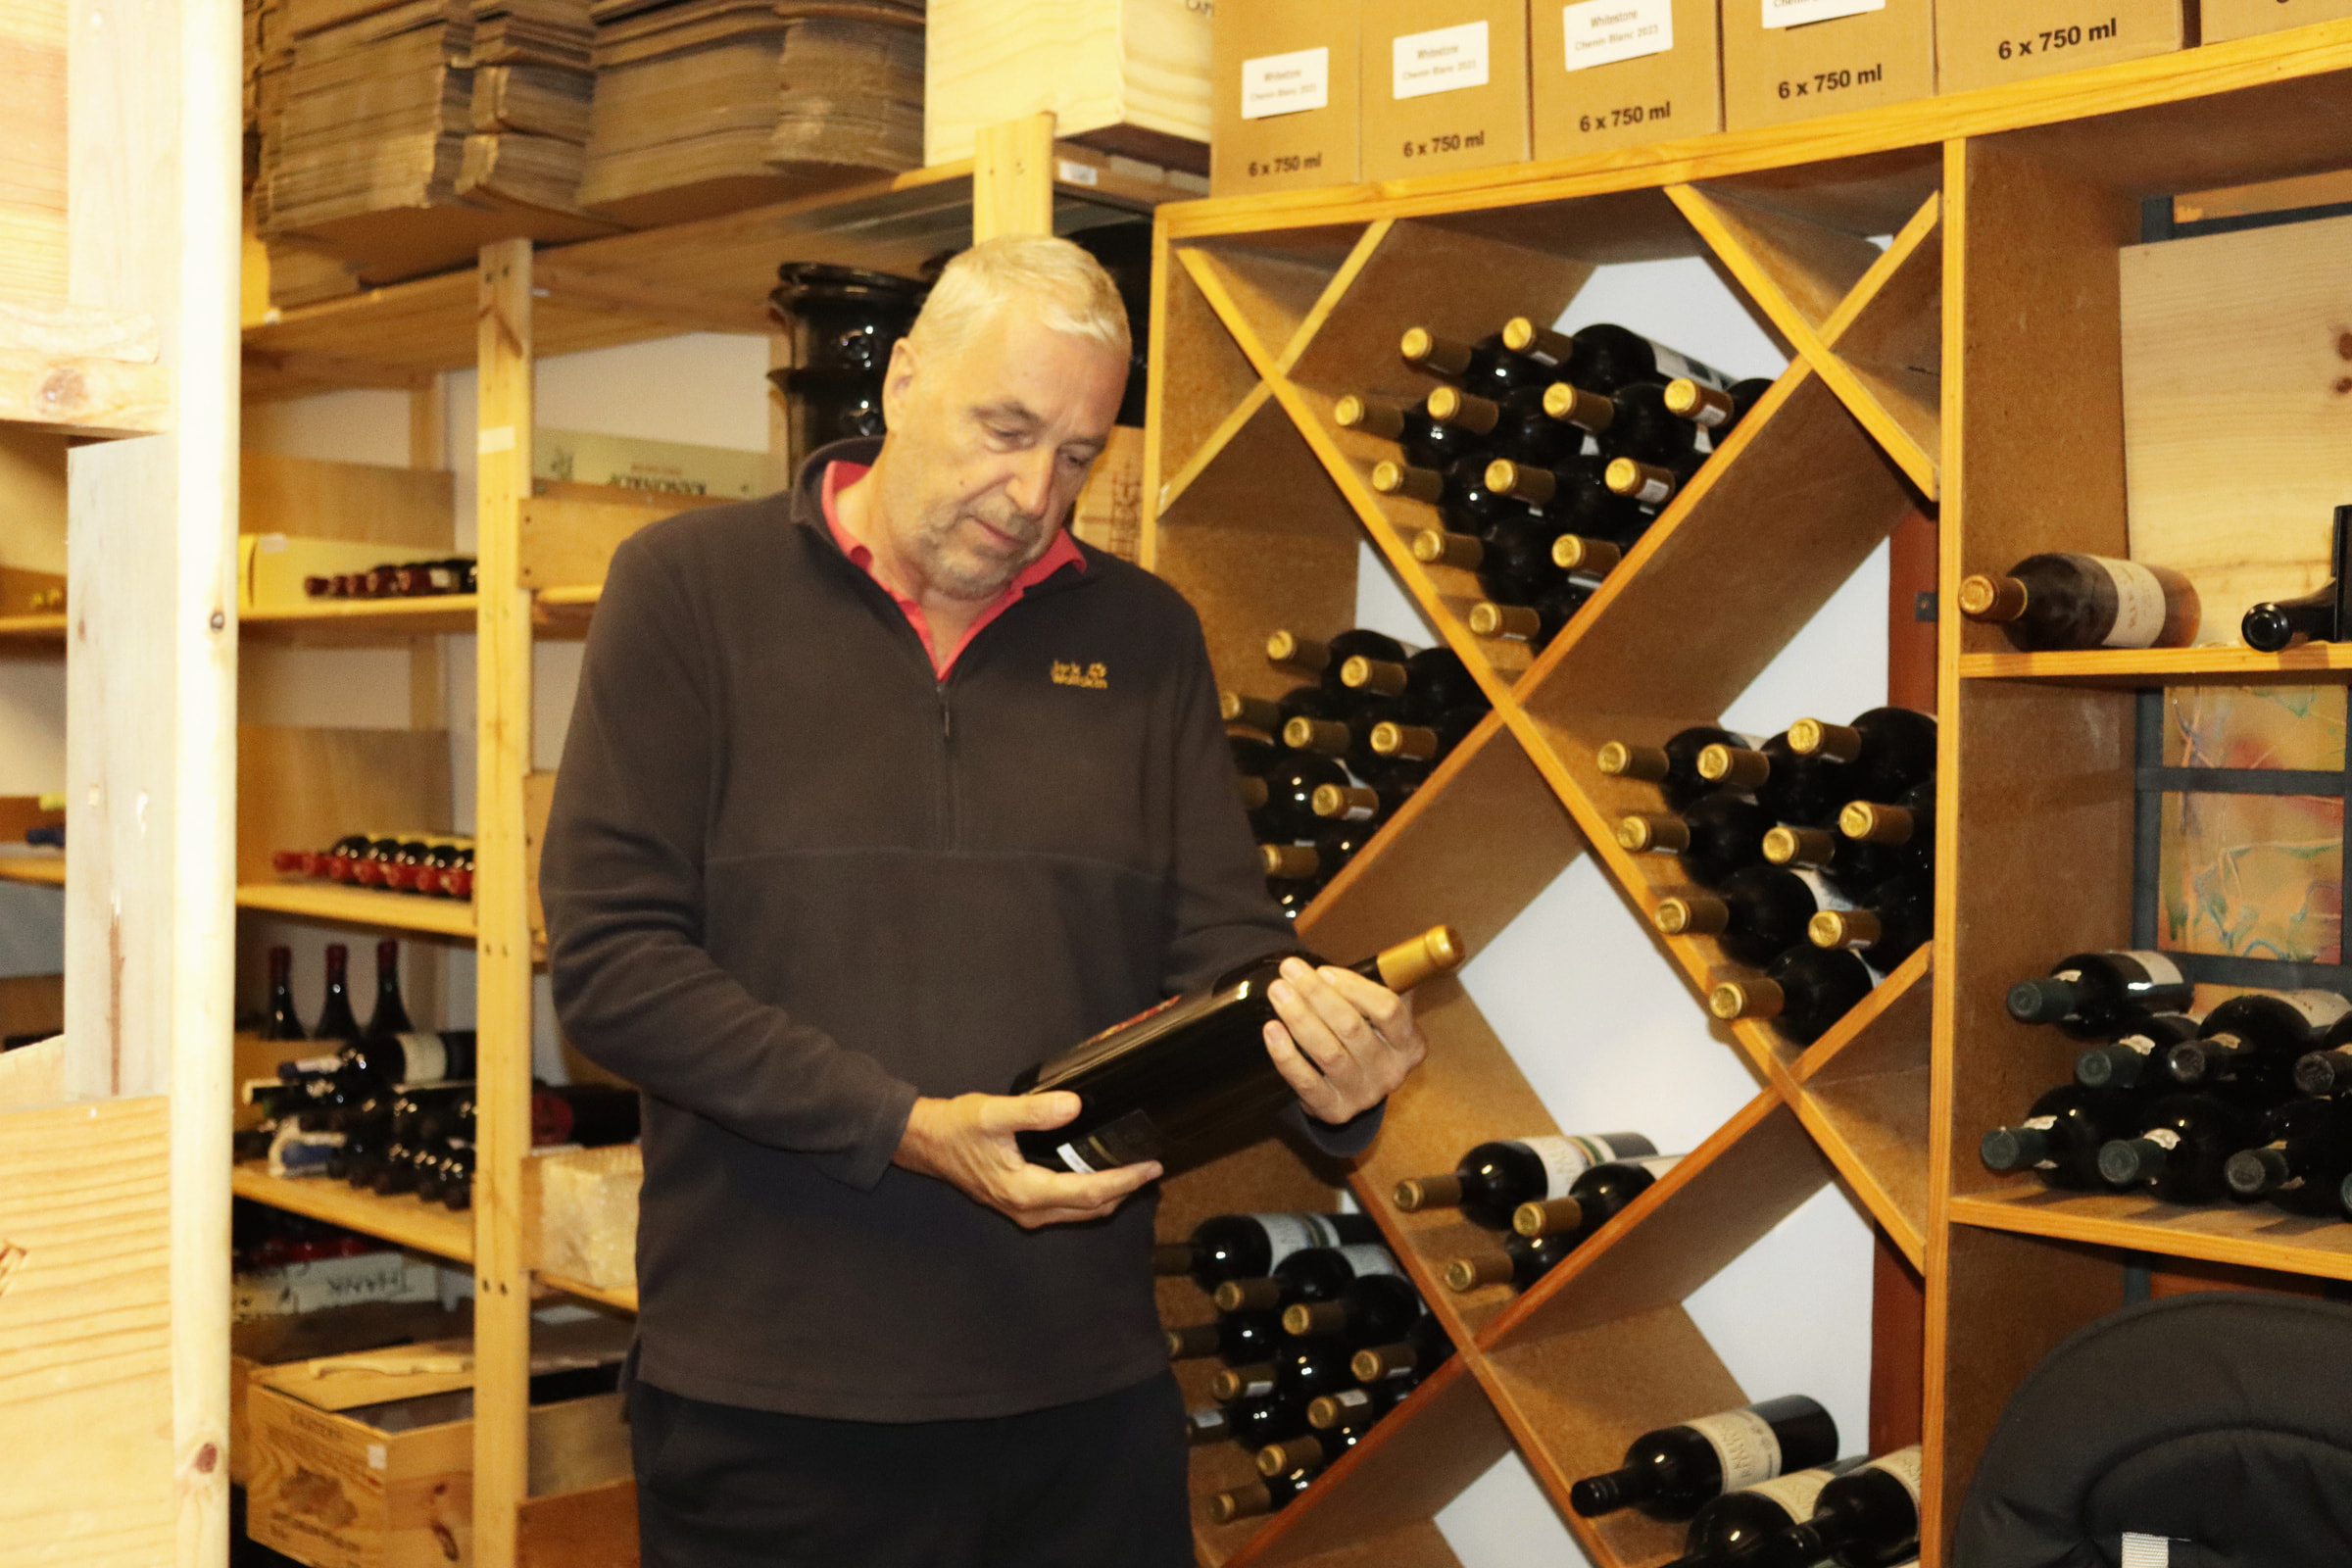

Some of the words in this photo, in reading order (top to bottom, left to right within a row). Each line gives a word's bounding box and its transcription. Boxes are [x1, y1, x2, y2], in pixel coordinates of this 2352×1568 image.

[1591, 9, 1638, 27] Whitestone
[1575, 37, 1606, 51] Chenin
[1608, 30, 1634, 44] Blanc
[1998, 40, 2012, 60] 6
[2019, 40, 2033, 56] x
[2039, 25, 2082, 52] 750
[2088, 18, 2117, 41] ml
[1778, 81, 1790, 99] 6
[1796, 82, 1808, 96] x
[1814, 70, 1851, 93] 750
[1857, 63, 1882, 85] ml
[1580, 115, 1591, 132] 6
[1595, 117, 1606, 129] x
[1611, 106, 1643, 127] 750
[1648, 101, 1671, 121] ml
[1403, 141, 1413, 158] 6
[1417, 144, 1426, 156] x
[1432, 134, 1461, 153] 750
[1465, 130, 1485, 148] ml
[1248, 161, 1258, 176] 6
[1261, 164, 1270, 174] x
[1274, 155, 1300, 172] 750
[1303, 151, 1321, 168] ml
